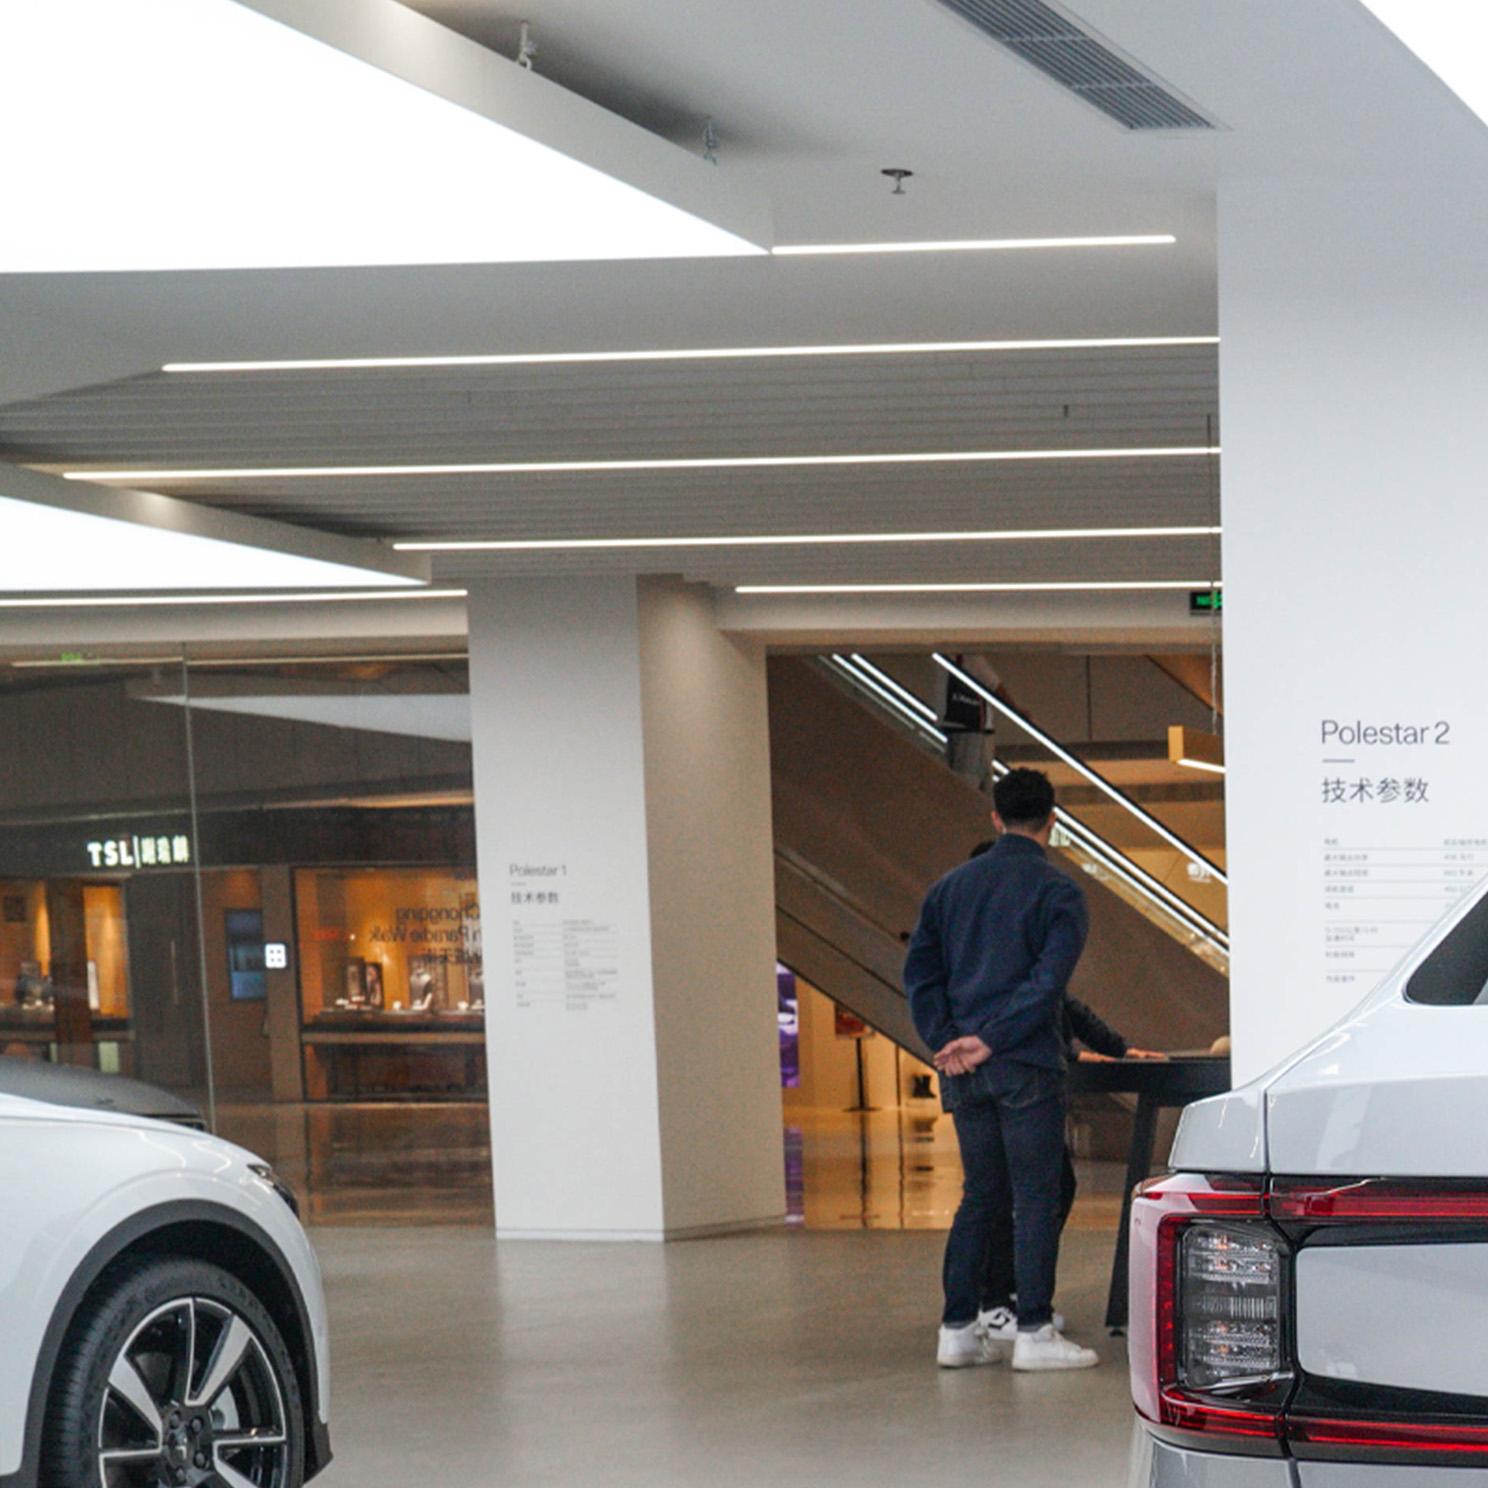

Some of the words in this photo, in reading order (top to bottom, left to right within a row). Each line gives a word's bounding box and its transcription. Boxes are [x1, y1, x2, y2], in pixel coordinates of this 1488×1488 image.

[1320, 719, 1429, 746] Polestar
[1434, 720, 1450, 745] 2
[1321, 777, 1430, 803] 技术参数
[87, 841, 134, 867] TSL
[509, 863, 558, 877] Polestar
[561, 863, 568, 876] 1
